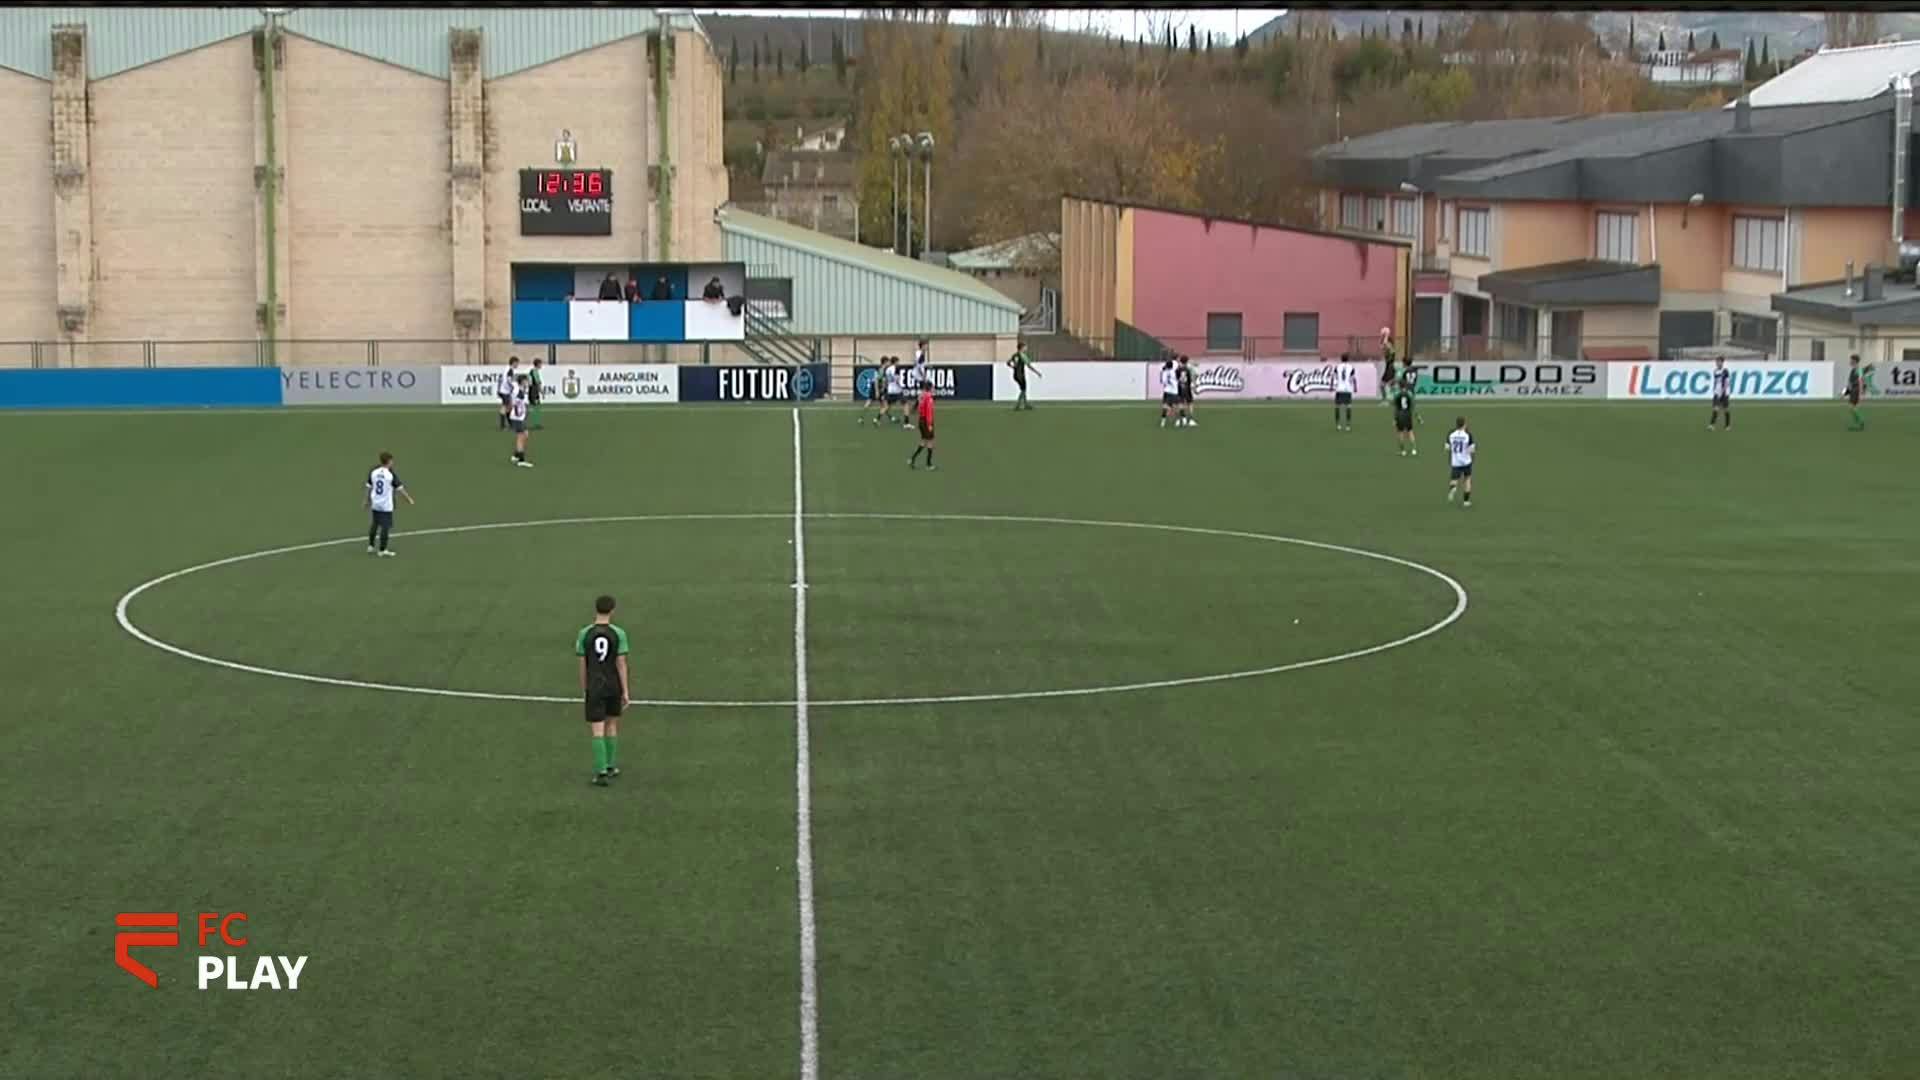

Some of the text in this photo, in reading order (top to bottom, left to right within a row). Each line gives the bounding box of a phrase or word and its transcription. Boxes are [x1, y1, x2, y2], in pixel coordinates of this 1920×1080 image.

[521, 198, 552, 213] LOCAL
[465, 372, 498, 383] AYUNT
[599, 371, 659, 382] ARANGUREN
[449, 385, 493, 396] VALLE DE
[635, 385, 670, 395] UDALA
[375, 480, 384, 495] 8
[594, 636, 609, 662] 9
